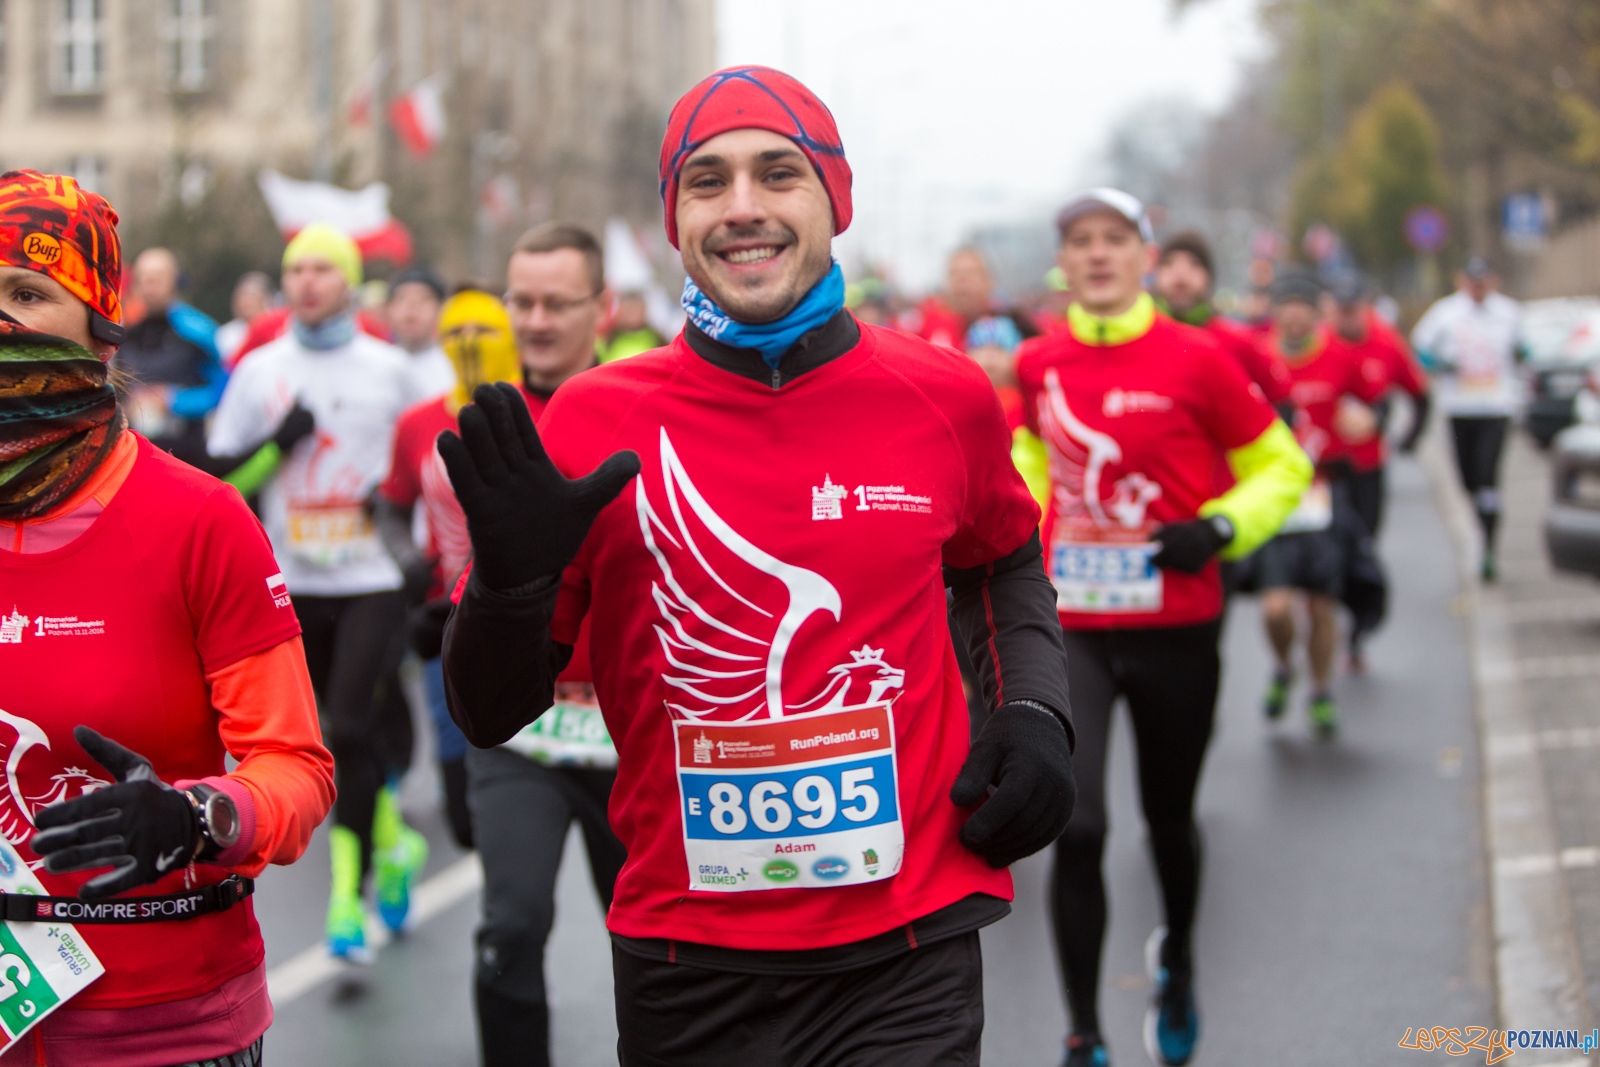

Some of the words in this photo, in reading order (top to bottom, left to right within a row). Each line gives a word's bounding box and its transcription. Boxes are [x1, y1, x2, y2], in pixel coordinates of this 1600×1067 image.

[27, 236, 60, 262] Buff
[853, 485, 870, 511] 1
[866, 485, 905, 493] Poznański
[866, 493, 884, 502] Bieg
[274, 595, 291, 609] POLS
[34, 615, 46, 636] 1
[790, 727, 879, 750] RunPoland.org
[716, 741, 727, 759] 1
[688, 797, 702, 816] E
[708, 766, 880, 835] 8695
[774, 843, 816, 854] Adam
[699, 865, 730, 875] GRUPA
[700, 875, 737, 885] LUXMED
[54, 897, 198, 918] COMPRESSPORT
[57, 943, 83, 976] GRUPA
[61, 933, 91, 971] LUXMED
[19, 999, 36, 1018] C
